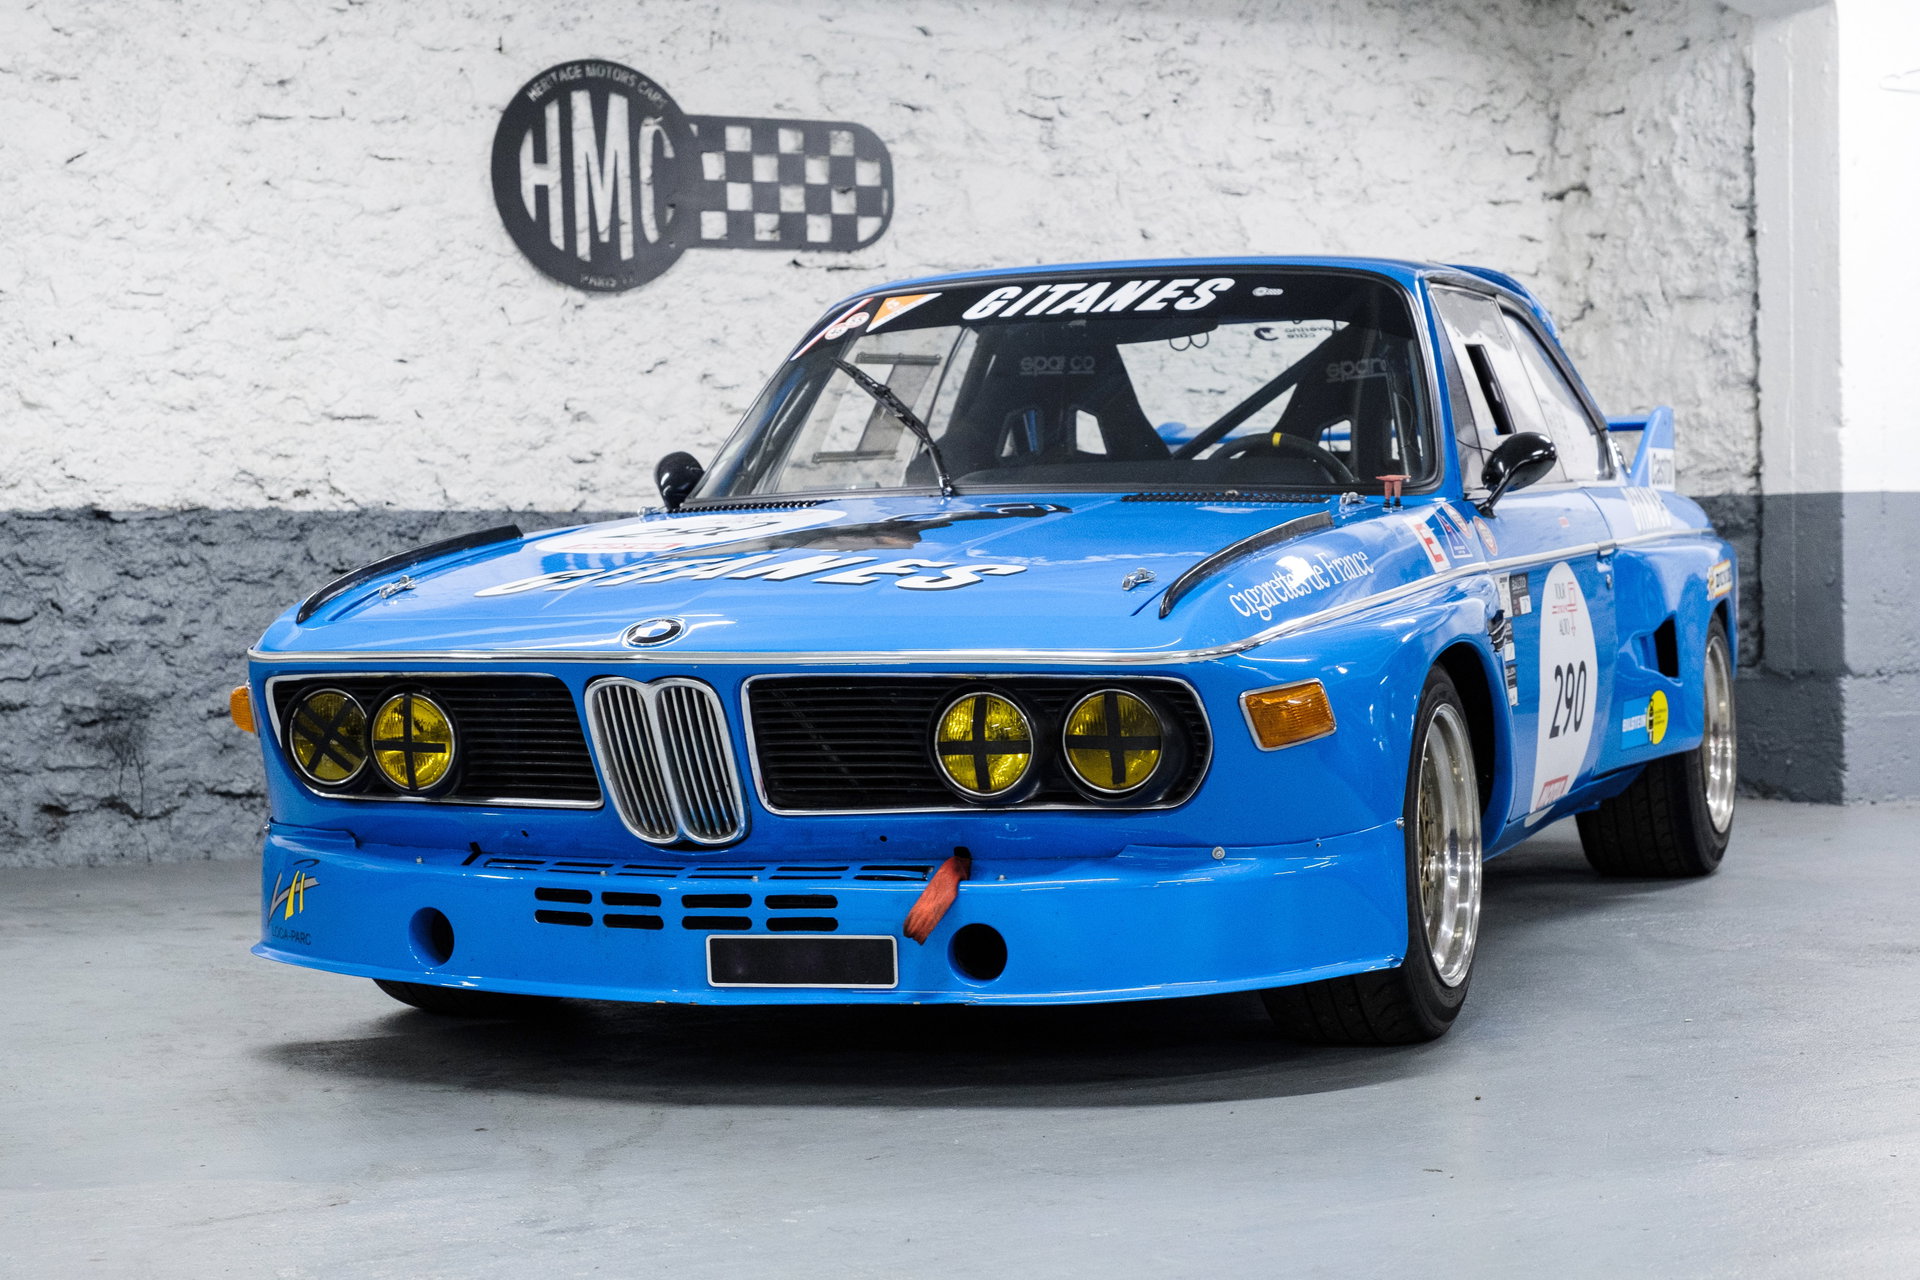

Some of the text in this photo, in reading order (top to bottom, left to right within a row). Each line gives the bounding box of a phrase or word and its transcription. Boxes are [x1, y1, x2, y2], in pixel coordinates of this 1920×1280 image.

[519, 89, 675, 262] HMC
[962, 277, 1236, 320] GITANES
[1314, 552, 1375, 585] France
[1549, 660, 1587, 739] 290
